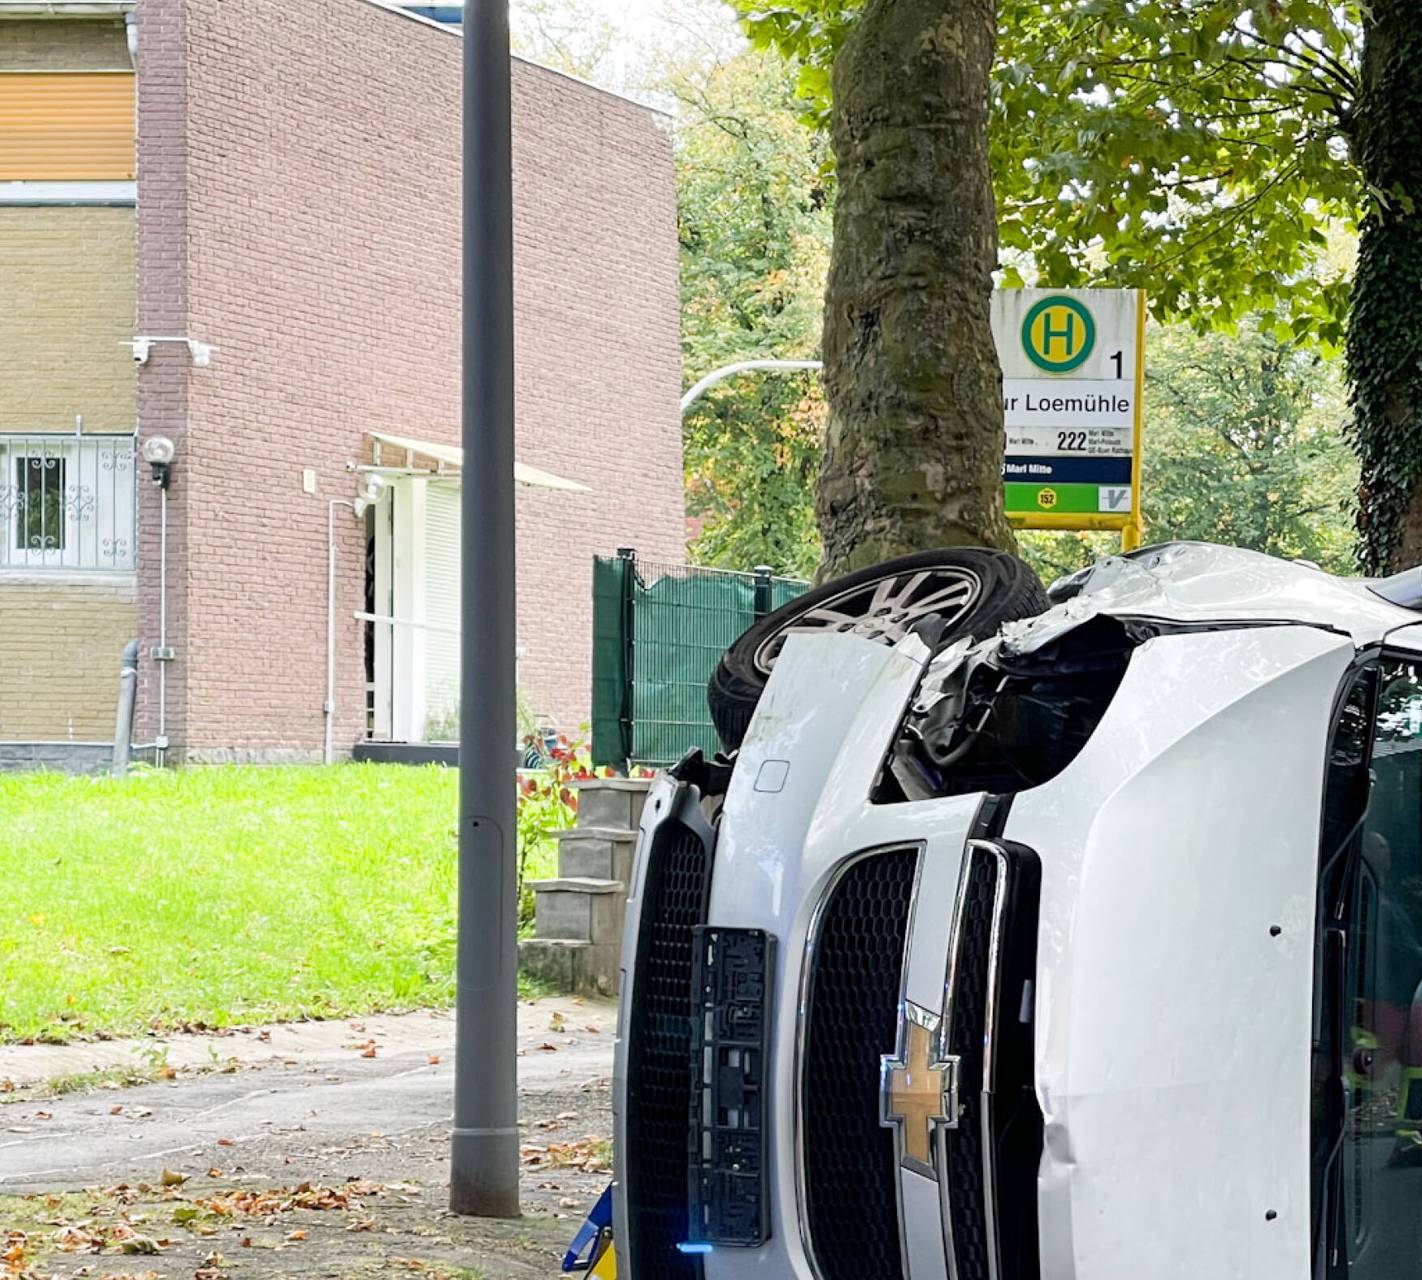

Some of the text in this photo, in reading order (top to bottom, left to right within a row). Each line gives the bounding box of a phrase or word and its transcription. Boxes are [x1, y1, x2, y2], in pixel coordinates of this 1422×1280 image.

[1043, 312, 1074, 356] H
[1110, 351, 1123, 379] 1
[1025, 394, 1129, 412] Loemühle
[1057, 431, 1087, 451] 222
